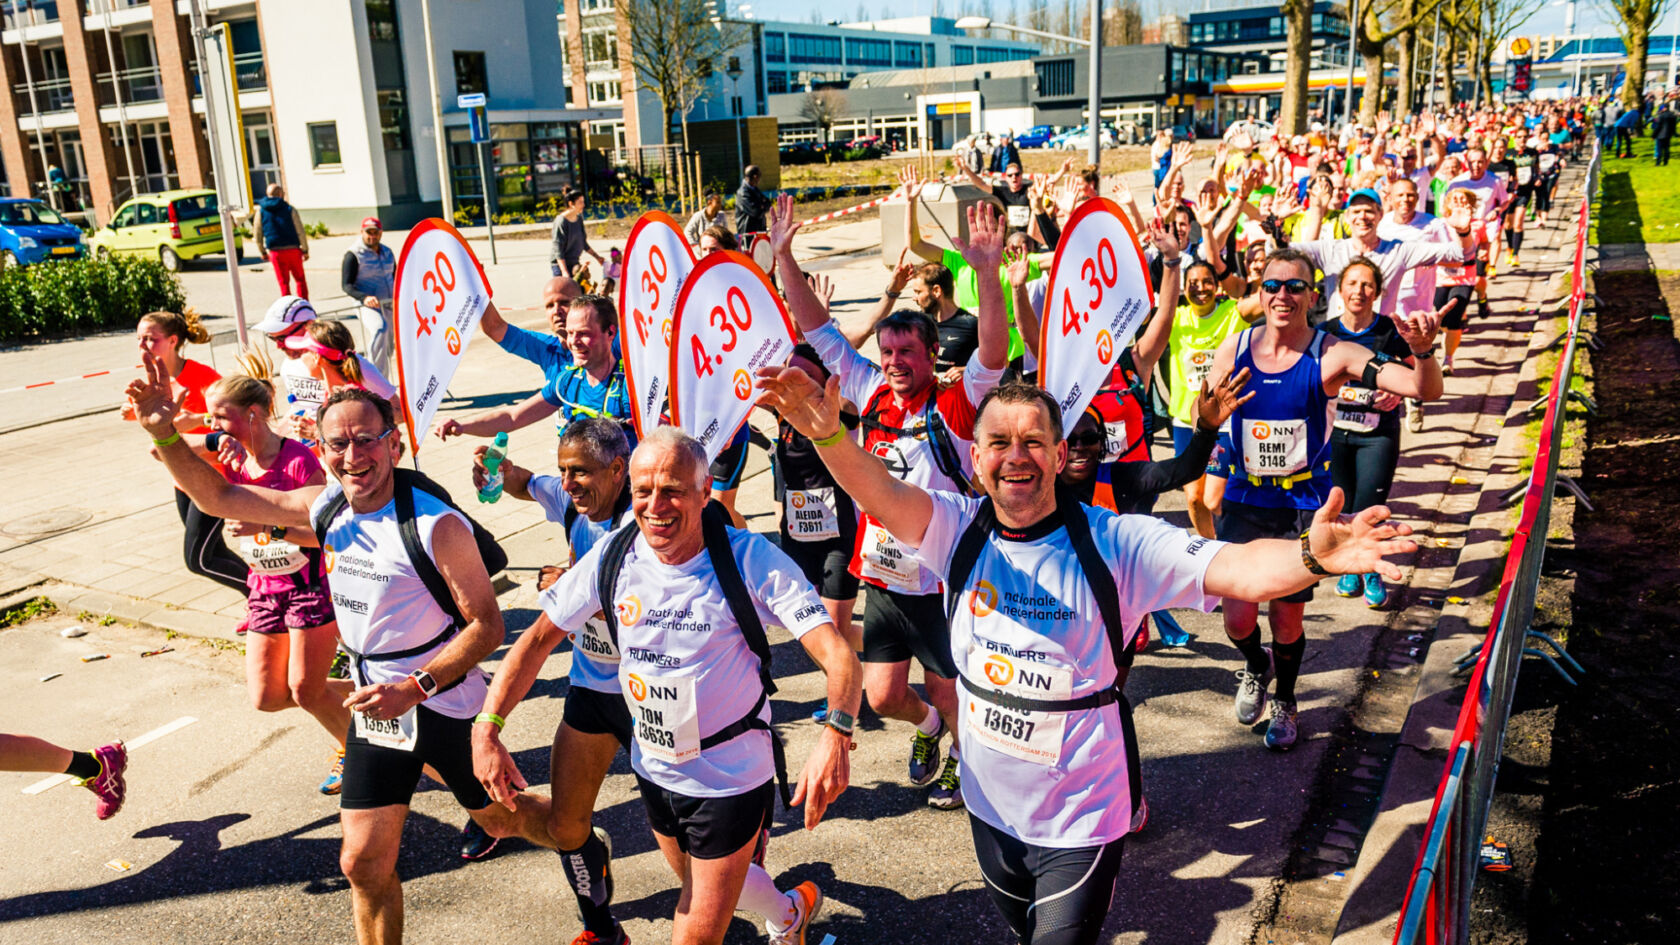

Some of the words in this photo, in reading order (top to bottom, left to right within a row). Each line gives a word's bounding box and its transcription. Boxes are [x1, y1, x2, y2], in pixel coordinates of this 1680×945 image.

[413, 251, 456, 339] 4.30
[1062, 238, 1118, 338] 4.30
[1110, 298, 1132, 331] nationale
[1114, 298, 1142, 342] nederlanden
[690, 286, 752, 379] 4.30
[747, 338, 772, 369] nationale
[752, 338, 783, 379] nderlanden
[1274, 427, 1294, 436] NN
[1259, 442, 1286, 453] REMI
[1259, 455, 1286, 468] 3148
[807, 495, 824, 504] NN
[795, 510, 824, 520] ALEIDA
[799, 521, 823, 533] F3611
[876, 542, 903, 559] DENNIS
[339, 554, 375, 570] nationale
[337, 565, 389, 583] nederlanden
[1018, 670, 1052, 690] NN
[650, 686, 677, 701] NN
[639, 705, 663, 727] TON
[984, 707, 1035, 742] 13637
[638, 721, 675, 749] 13633
